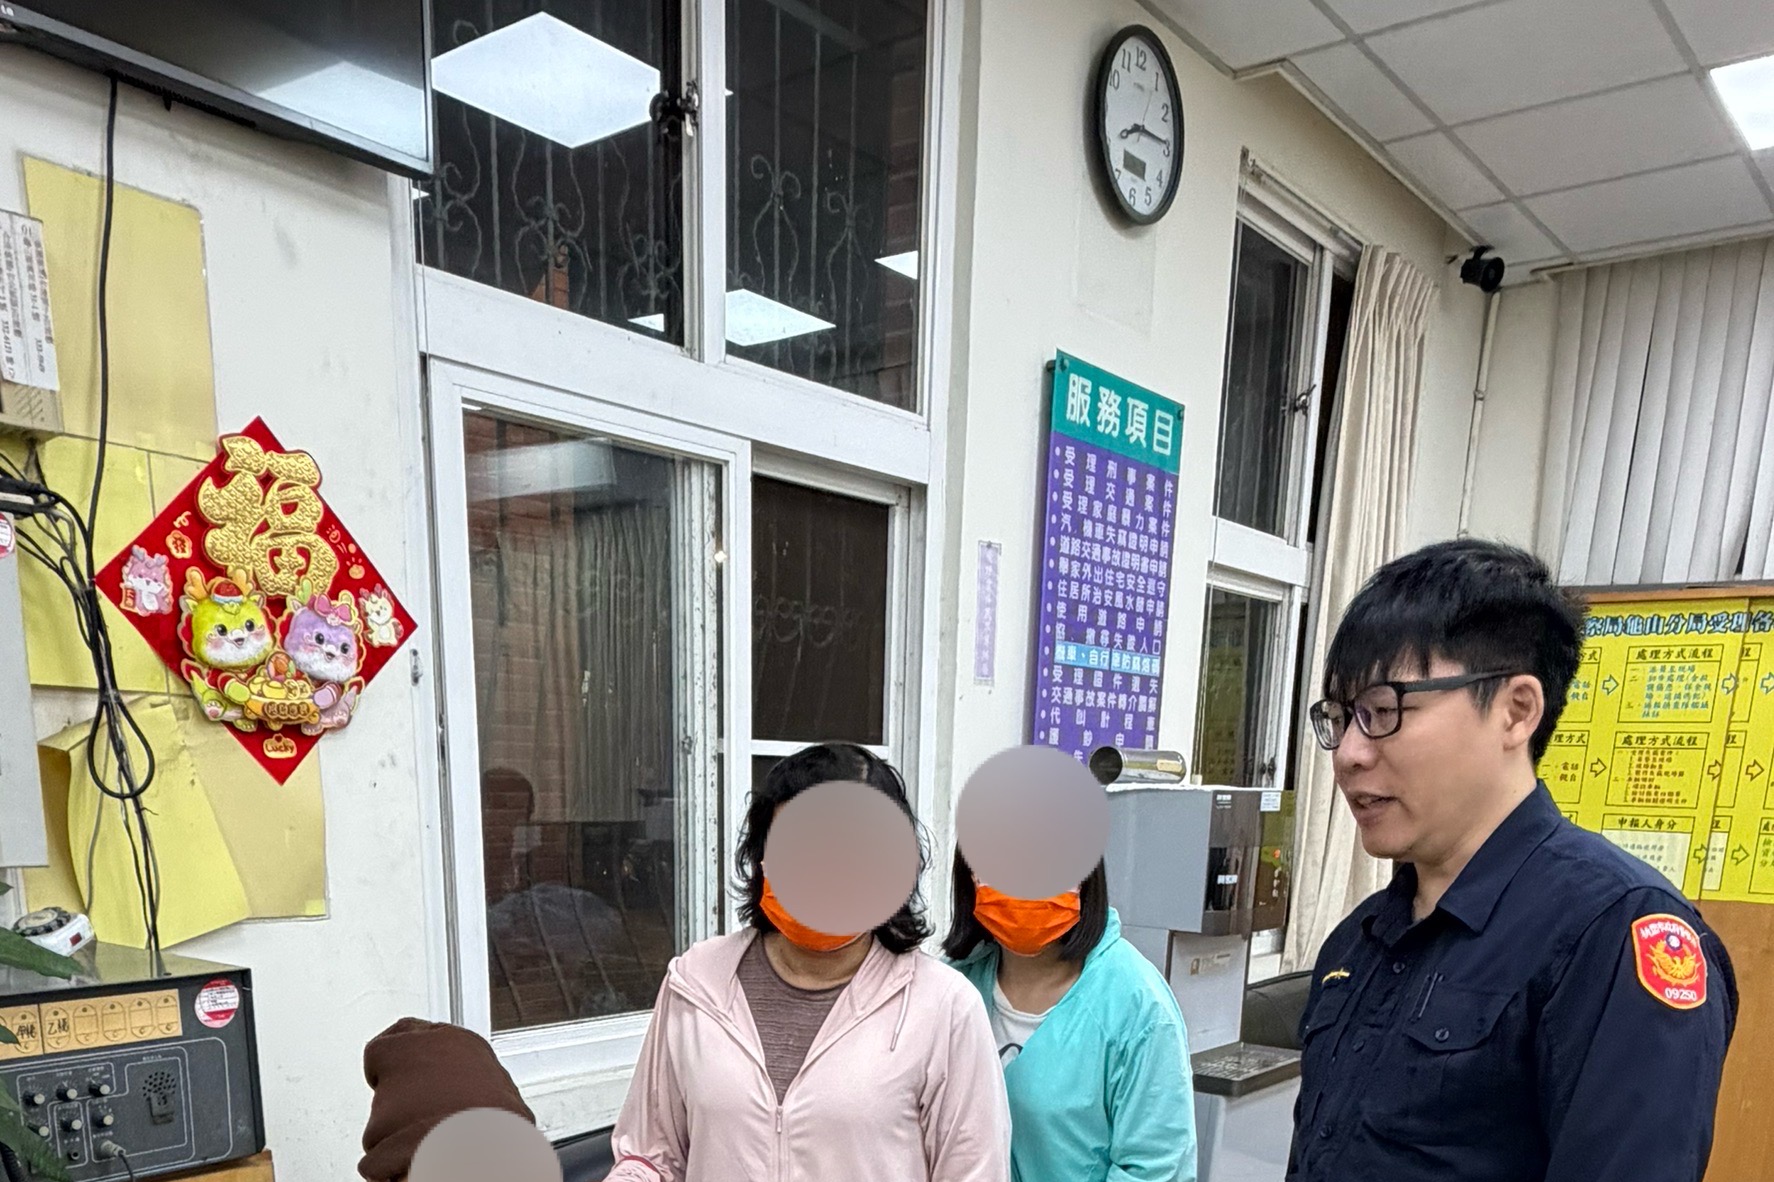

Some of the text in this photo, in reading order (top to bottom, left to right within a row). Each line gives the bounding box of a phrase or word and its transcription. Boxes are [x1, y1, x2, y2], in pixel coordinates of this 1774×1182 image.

[1122, 49, 1131, 73] 11
[1136, 46, 1147, 71] 12
[1109, 69, 1120, 91] 10
[1154, 72, 1159, 91] 1
[1161, 103, 1169, 123] 2
[1156, 170, 1163, 188] 4
[1129, 187, 1137, 207] 6
[1144, 186, 1152, 206] 5
[1066, 373, 1174, 456] 服務項目
[1065, 445, 1173, 498] 受理刑事案件
[199, 434, 339, 597] 福
[1062, 490, 1170, 537] 受理家庭暴力案件
[1060, 535, 1167, 578] 道路交通事故證明書申請
[1056, 600, 1163, 637] 使用道路申請
[1635, 648, 1713, 660] 處理方式流程
[1051, 686, 1157, 712] 交通事故案件轉介調解
[1050, 706, 1155, 731] 代叫計程車
[1553, 733, 1586, 743] 理方式
[1622, 735, 1698, 746] 處理方式流程
[1618, 817, 1676, 830] 申報人身分
